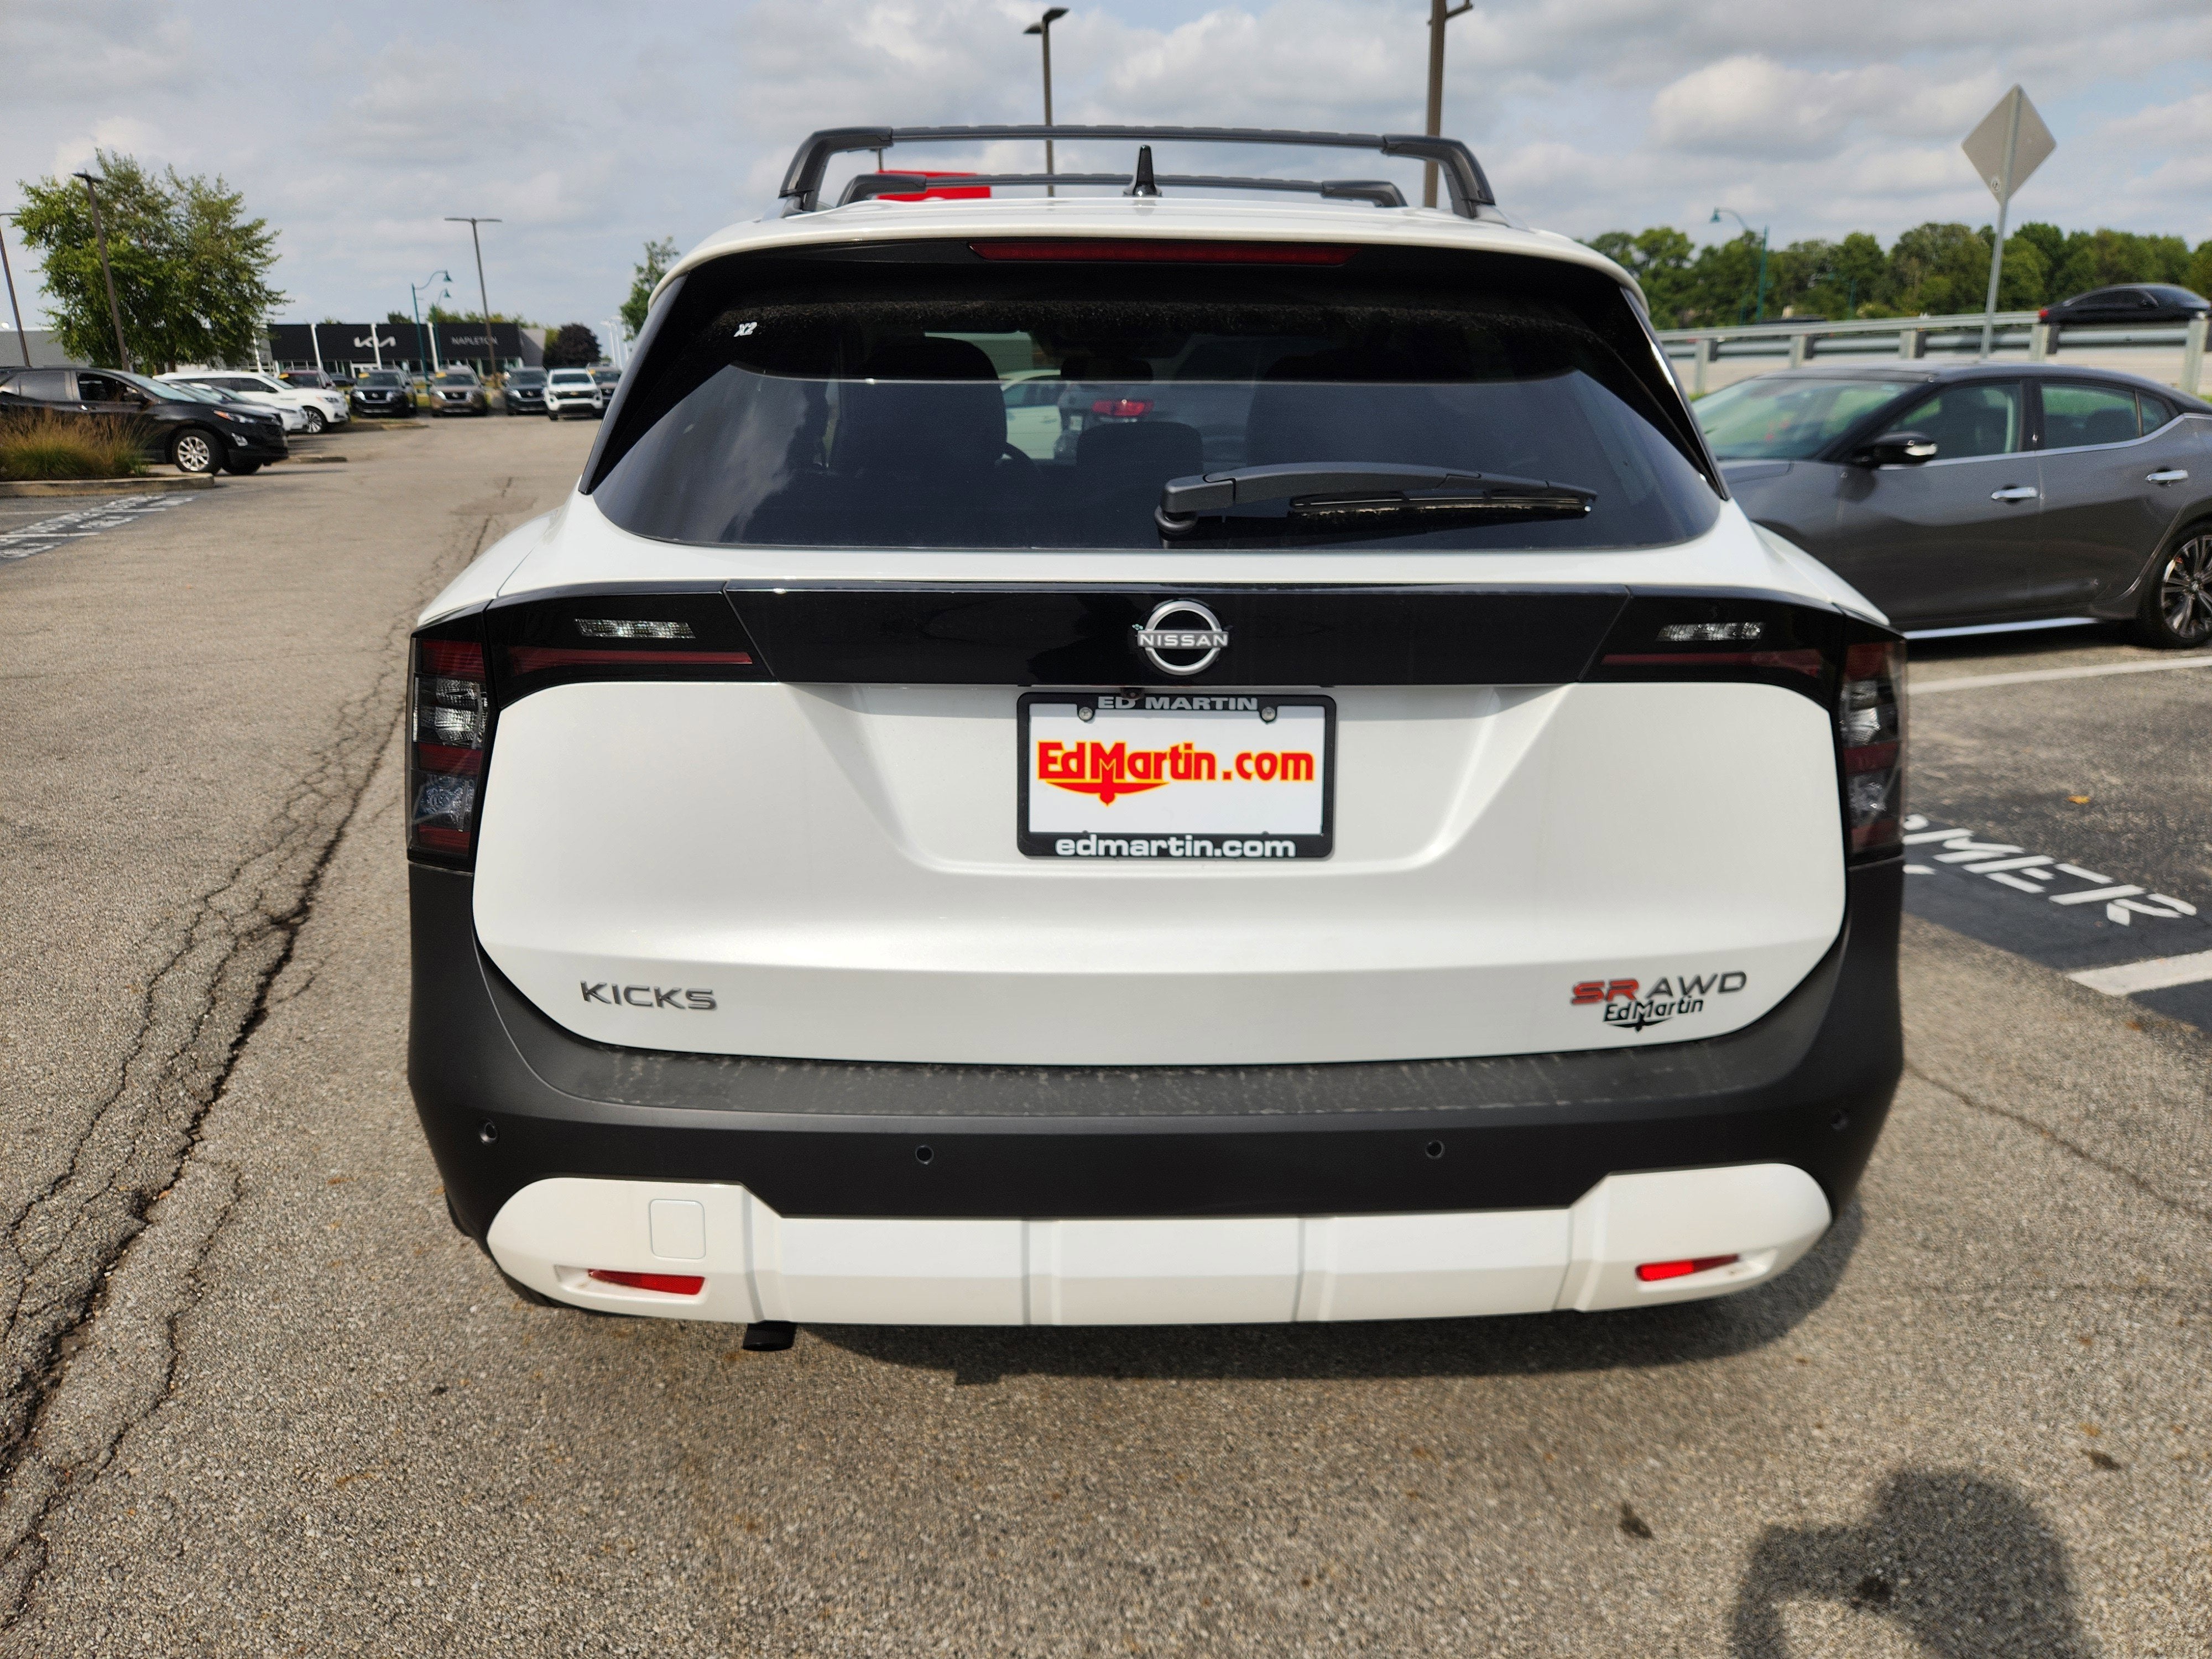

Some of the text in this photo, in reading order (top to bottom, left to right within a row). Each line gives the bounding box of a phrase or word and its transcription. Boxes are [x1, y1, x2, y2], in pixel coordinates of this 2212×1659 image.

[1138, 633, 1229, 647] NISSAN
[1097, 696, 1258, 711] ED MARTIN
[1055, 834, 1296, 858] edmartin.com
[580, 980, 718, 1010] KICKS
[1571, 970, 1747, 1005] SR AWD
